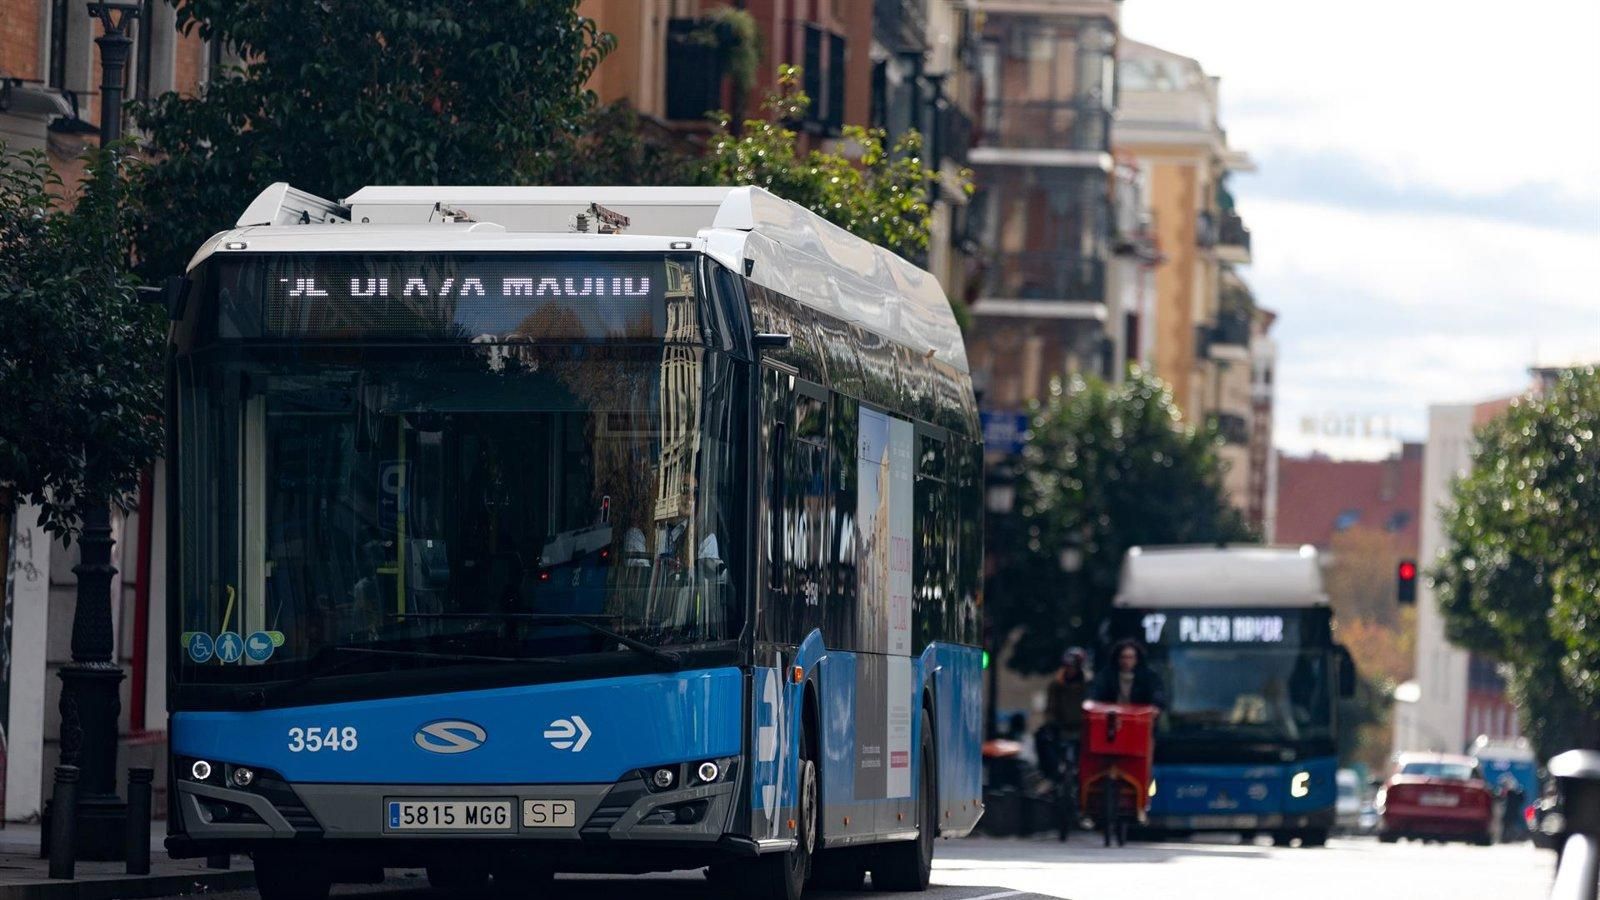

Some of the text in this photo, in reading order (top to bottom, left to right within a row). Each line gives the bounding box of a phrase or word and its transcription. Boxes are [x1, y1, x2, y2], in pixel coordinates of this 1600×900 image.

[1142, 613, 1167, 643] 17
[1179, 615, 1230, 642] PLAZA
[287, 726, 358, 752] 3548
[403, 805, 455, 825] 5815
[465, 805, 507, 825] MGG
[531, 803, 567, 823] SP
